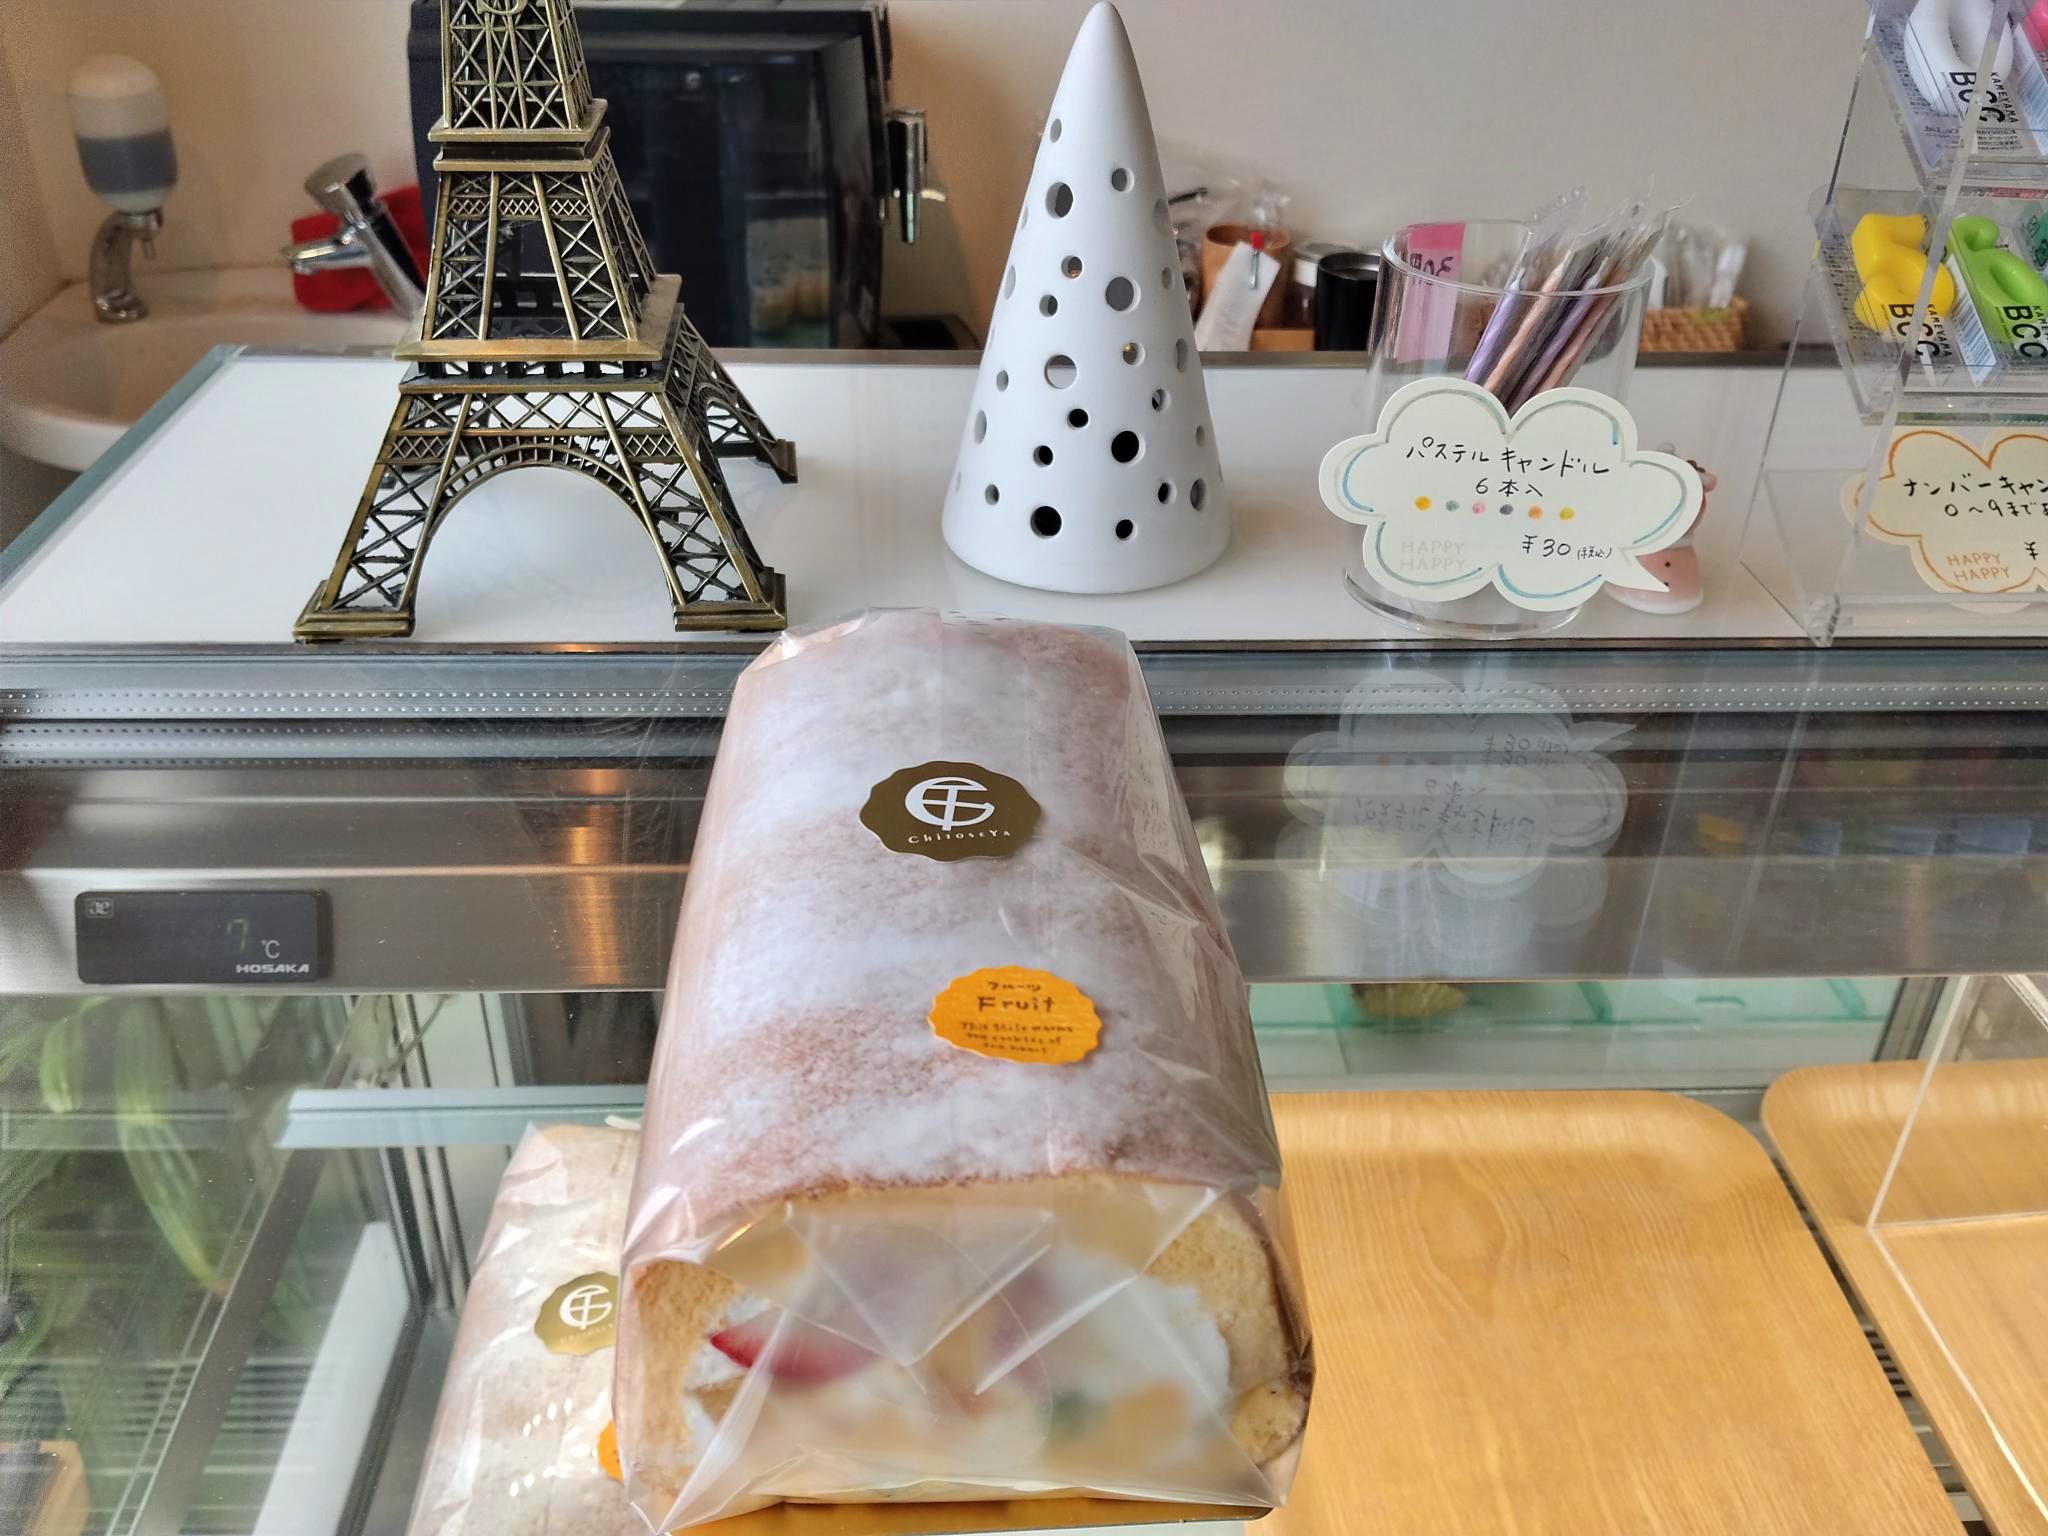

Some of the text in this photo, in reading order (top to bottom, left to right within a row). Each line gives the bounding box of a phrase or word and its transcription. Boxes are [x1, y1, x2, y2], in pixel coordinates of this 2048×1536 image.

[1990, 72, 2019, 124] KAMEYAMA
[1928, 303, 1953, 358] KAMEYAMA
[2002, 305, 2048, 358] BCC
[1401, 540, 1465, 556] HAPPY
[1400, 556, 1467, 572] HAPPY
[1946, 552, 2002, 567] HAPPY
[1953, 566, 2011, 583] HAPPY
[235, 963, 310, 974] HOSAKA
[977, 996, 1056, 1013] Fruit
